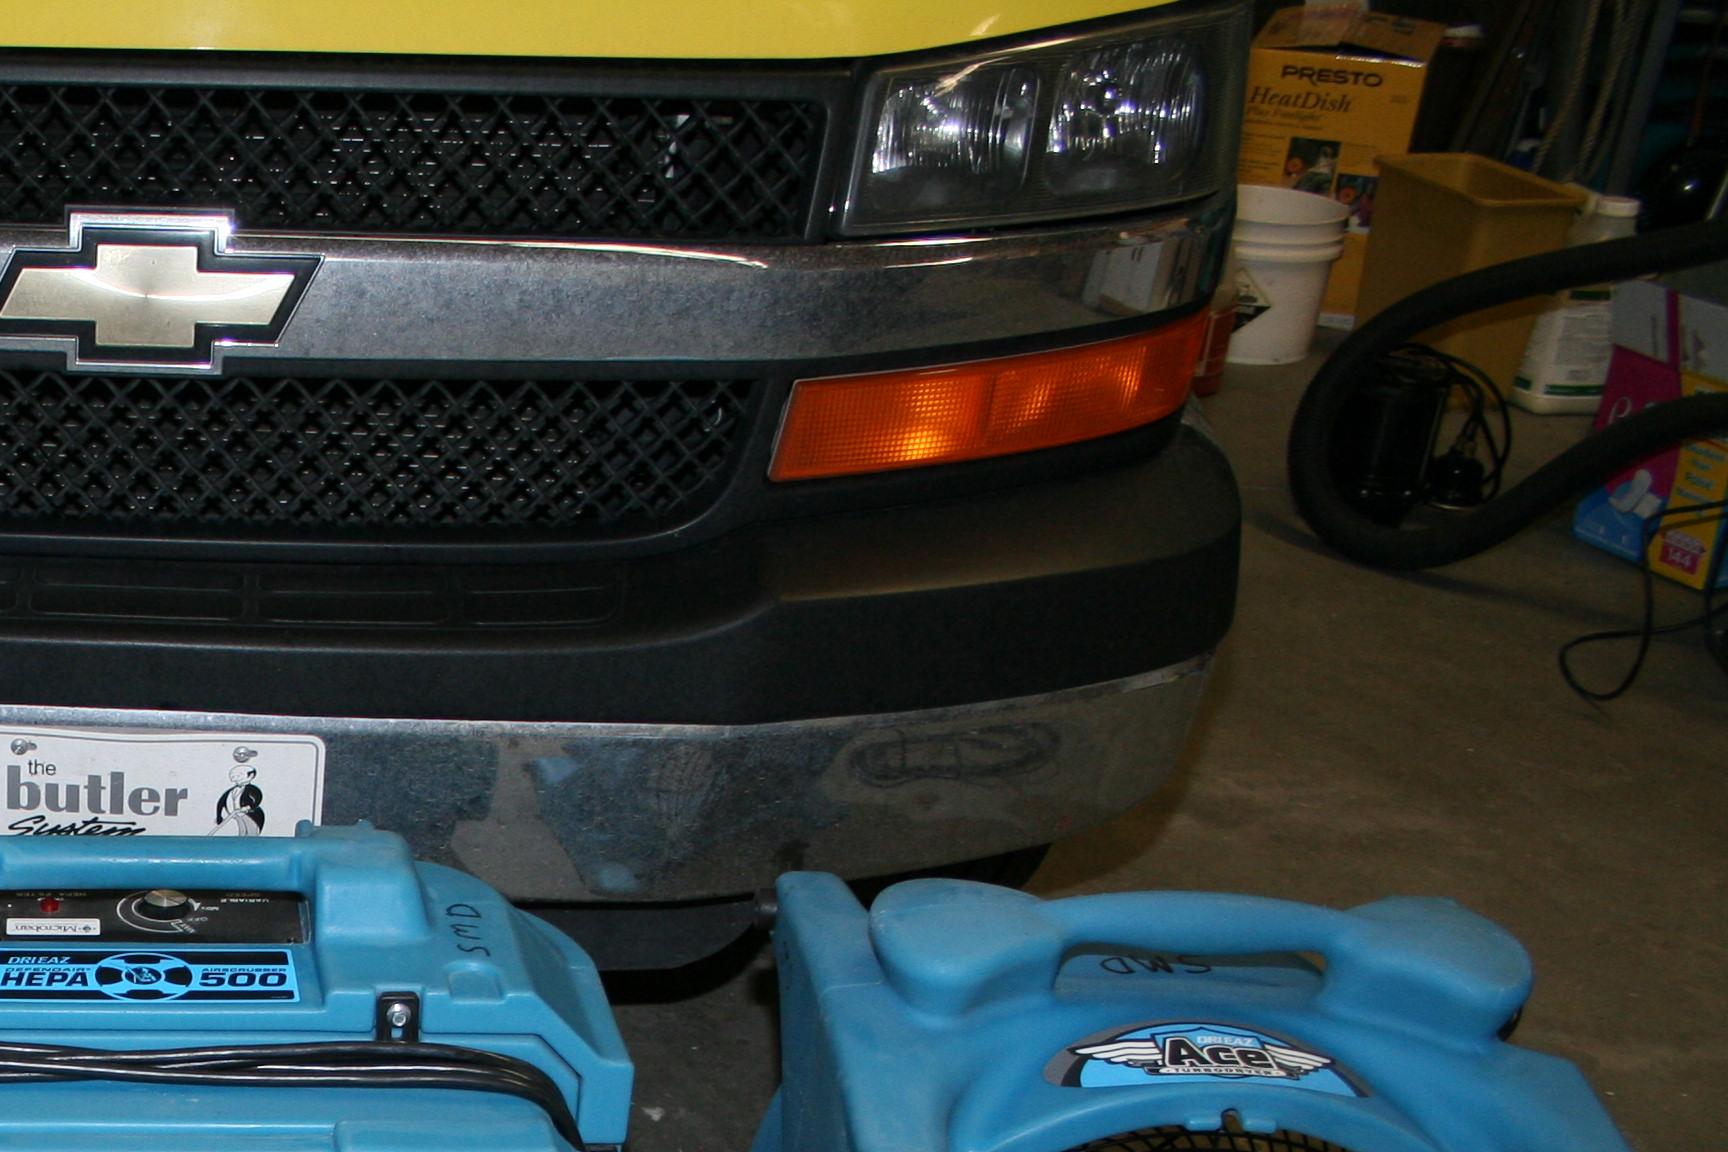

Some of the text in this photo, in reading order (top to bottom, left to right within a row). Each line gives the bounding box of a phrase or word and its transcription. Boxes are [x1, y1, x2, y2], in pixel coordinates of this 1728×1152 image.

[1281, 64, 1384, 88] PRESTO
[1248, 86, 1352, 112] HeatDish
[28, 759, 57, 776] the
[6, 765, 188, 817] butler
[13, 924, 77, 932] Microban
[0, 971, 288, 988] HEPA 500
[1165, 1037, 1278, 1071] Ace
